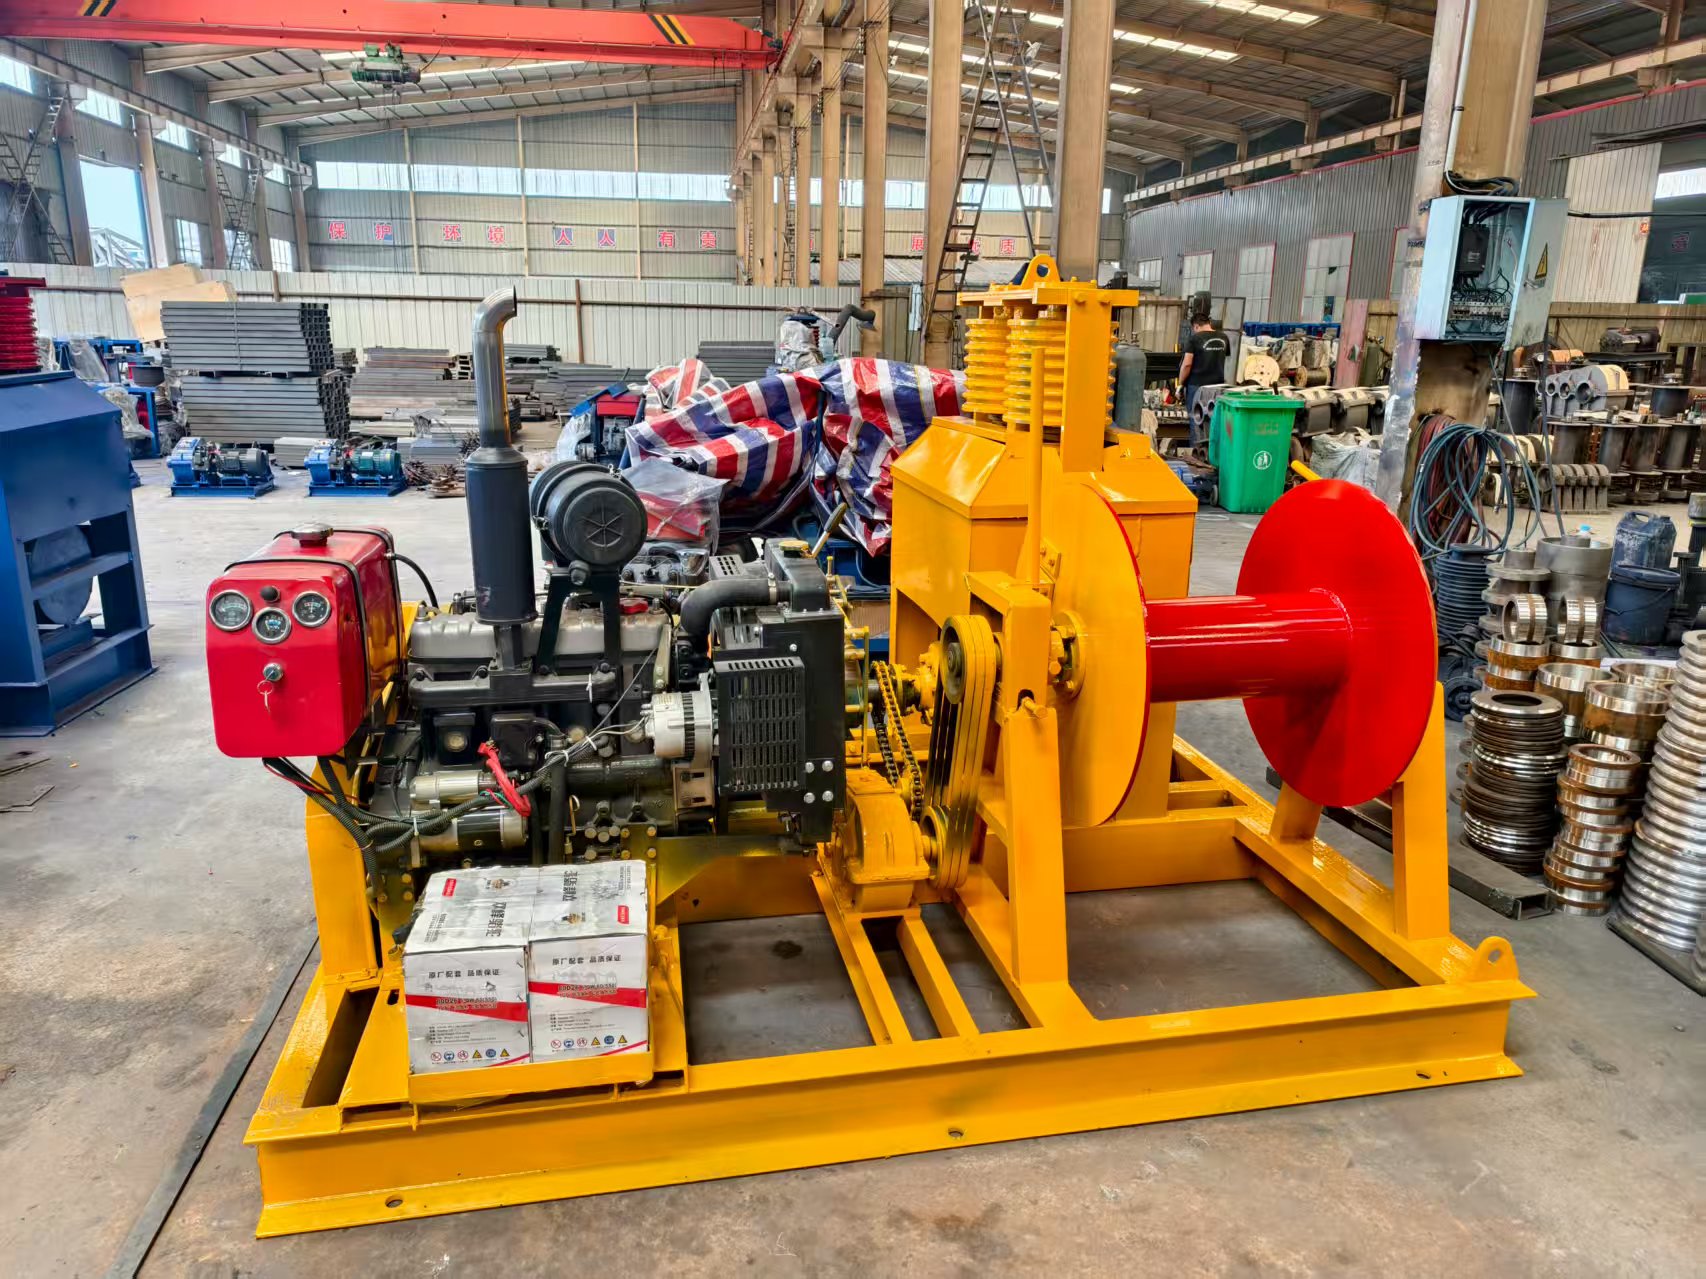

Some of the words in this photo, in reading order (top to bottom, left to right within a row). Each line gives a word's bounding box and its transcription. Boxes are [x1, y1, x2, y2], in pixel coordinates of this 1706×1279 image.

[552, 957, 585, 965] 原厂配套
[589, 955, 622, 963] 品质保证
[428, 971, 462, 979] 原厂配套
[467, 968, 501, 977] 品质保证
